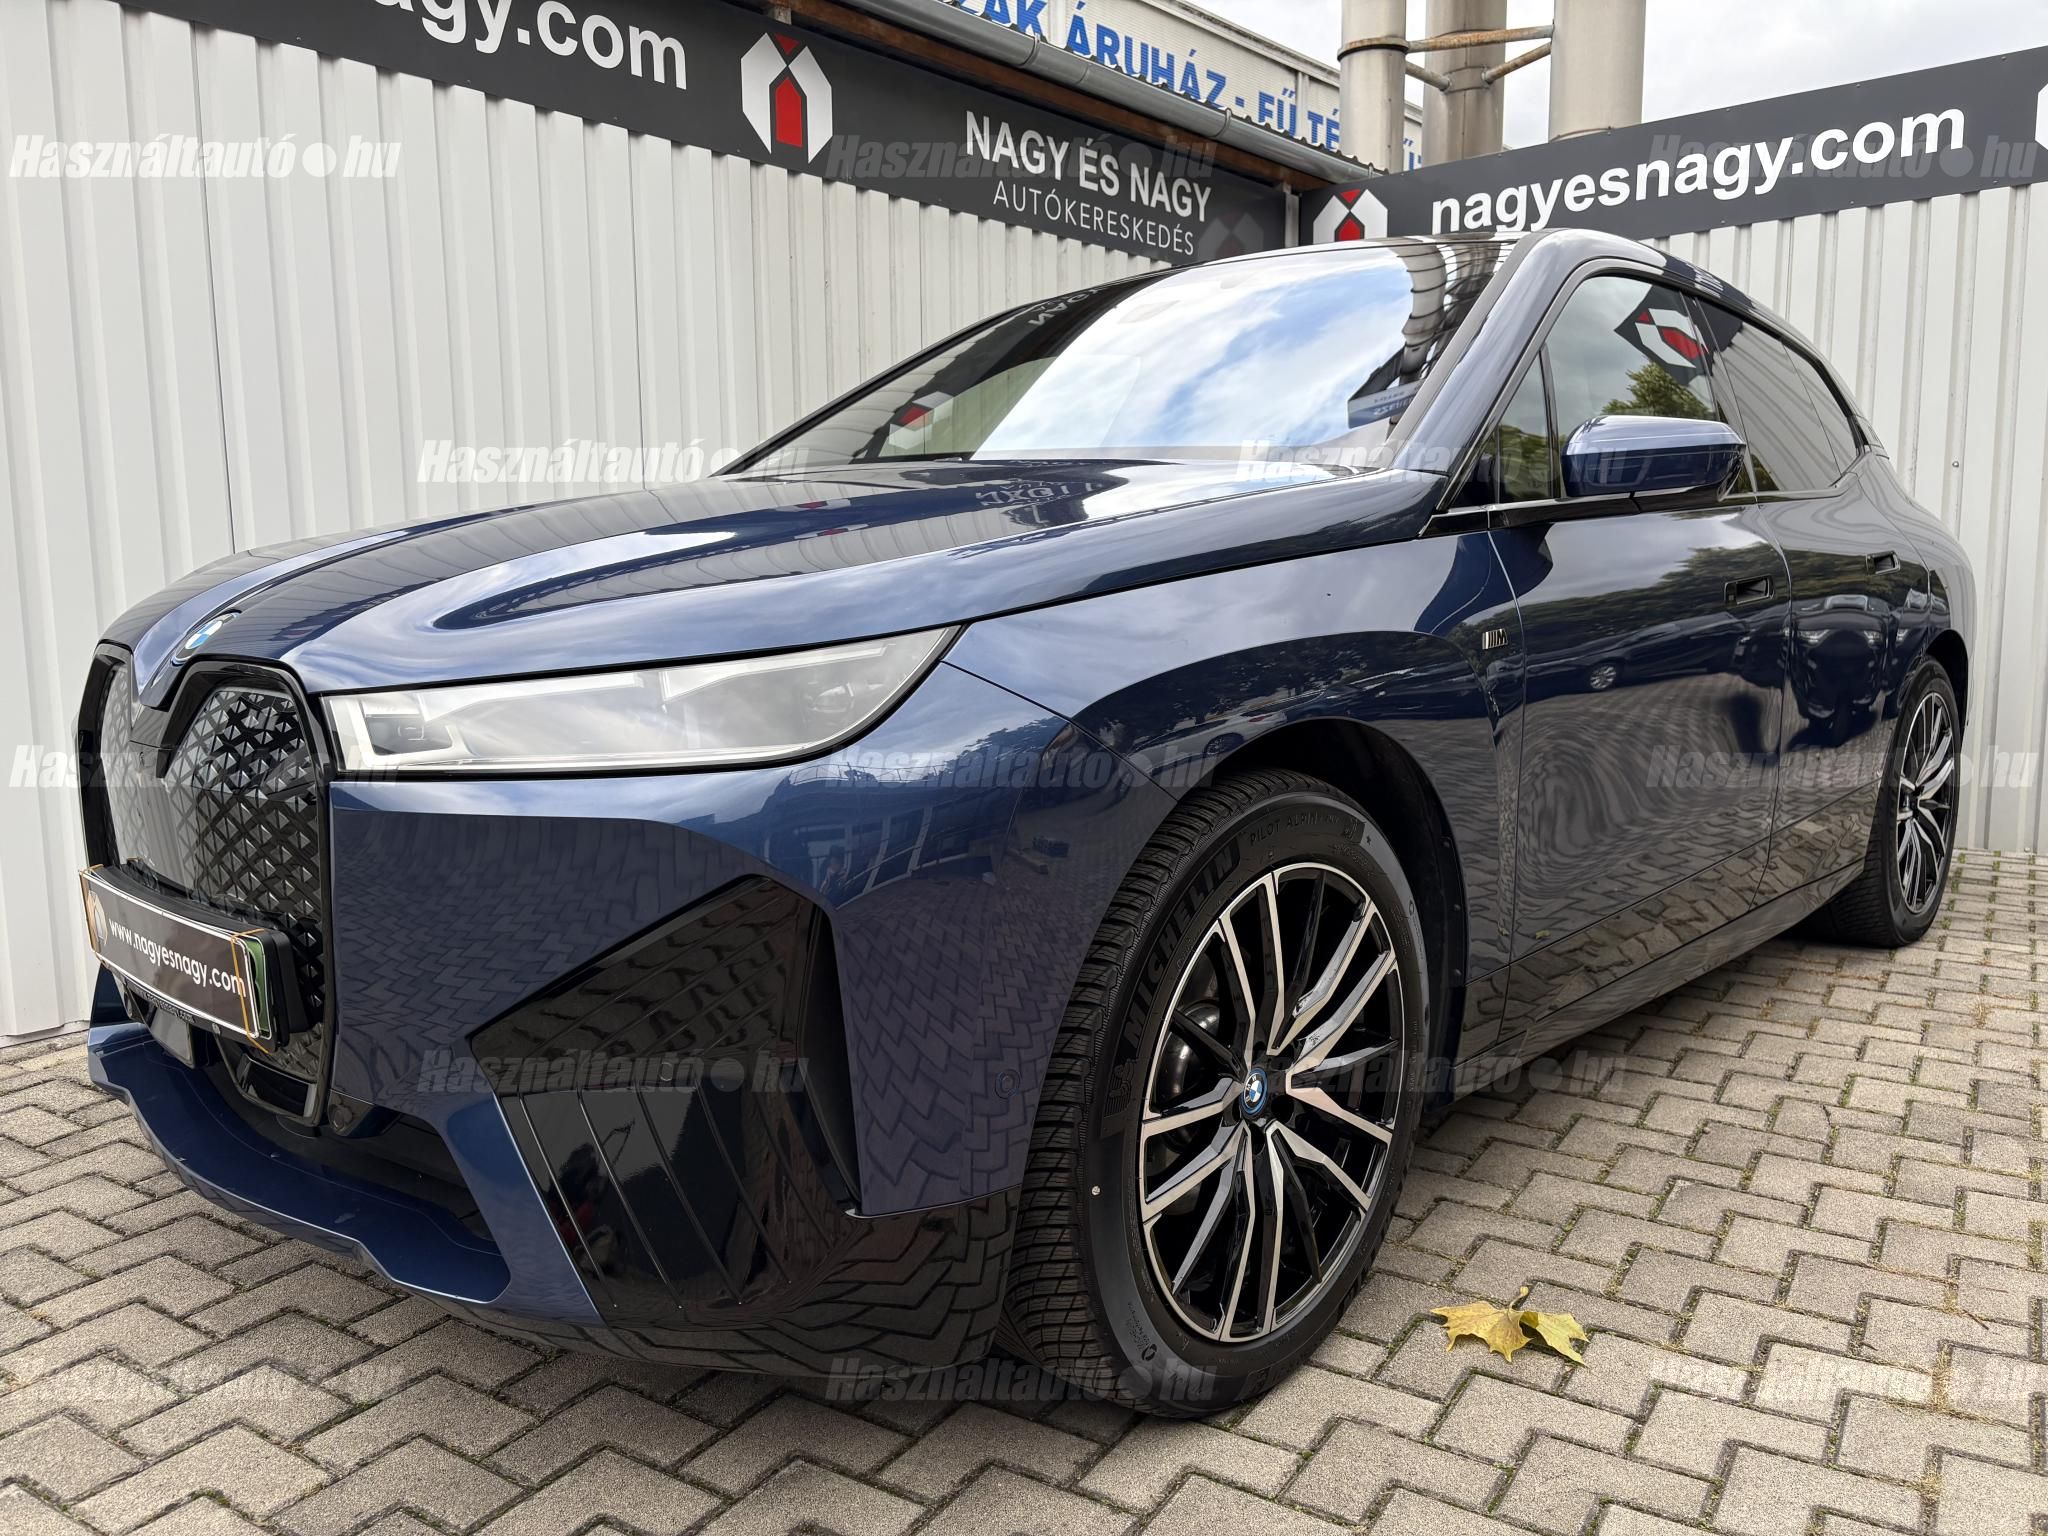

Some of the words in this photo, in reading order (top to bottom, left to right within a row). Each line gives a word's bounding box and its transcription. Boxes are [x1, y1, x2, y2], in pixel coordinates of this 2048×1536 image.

[1066, 1, 1227, 110] ÁRUHÁZ
[966, 110, 1070, 181] NAGY
[1079, 137, 1120, 197] ÉS
[1130, 162, 1212, 222] NAGY
[992, 180, 1194, 256] AUTÓKERESKEDÉS
[1431, 107, 1966, 235] nagyesnagy.com
[108, 918, 247, 998] www.nagyesnagy.com
[1122, 848, 1236, 1046] MICHELIN
